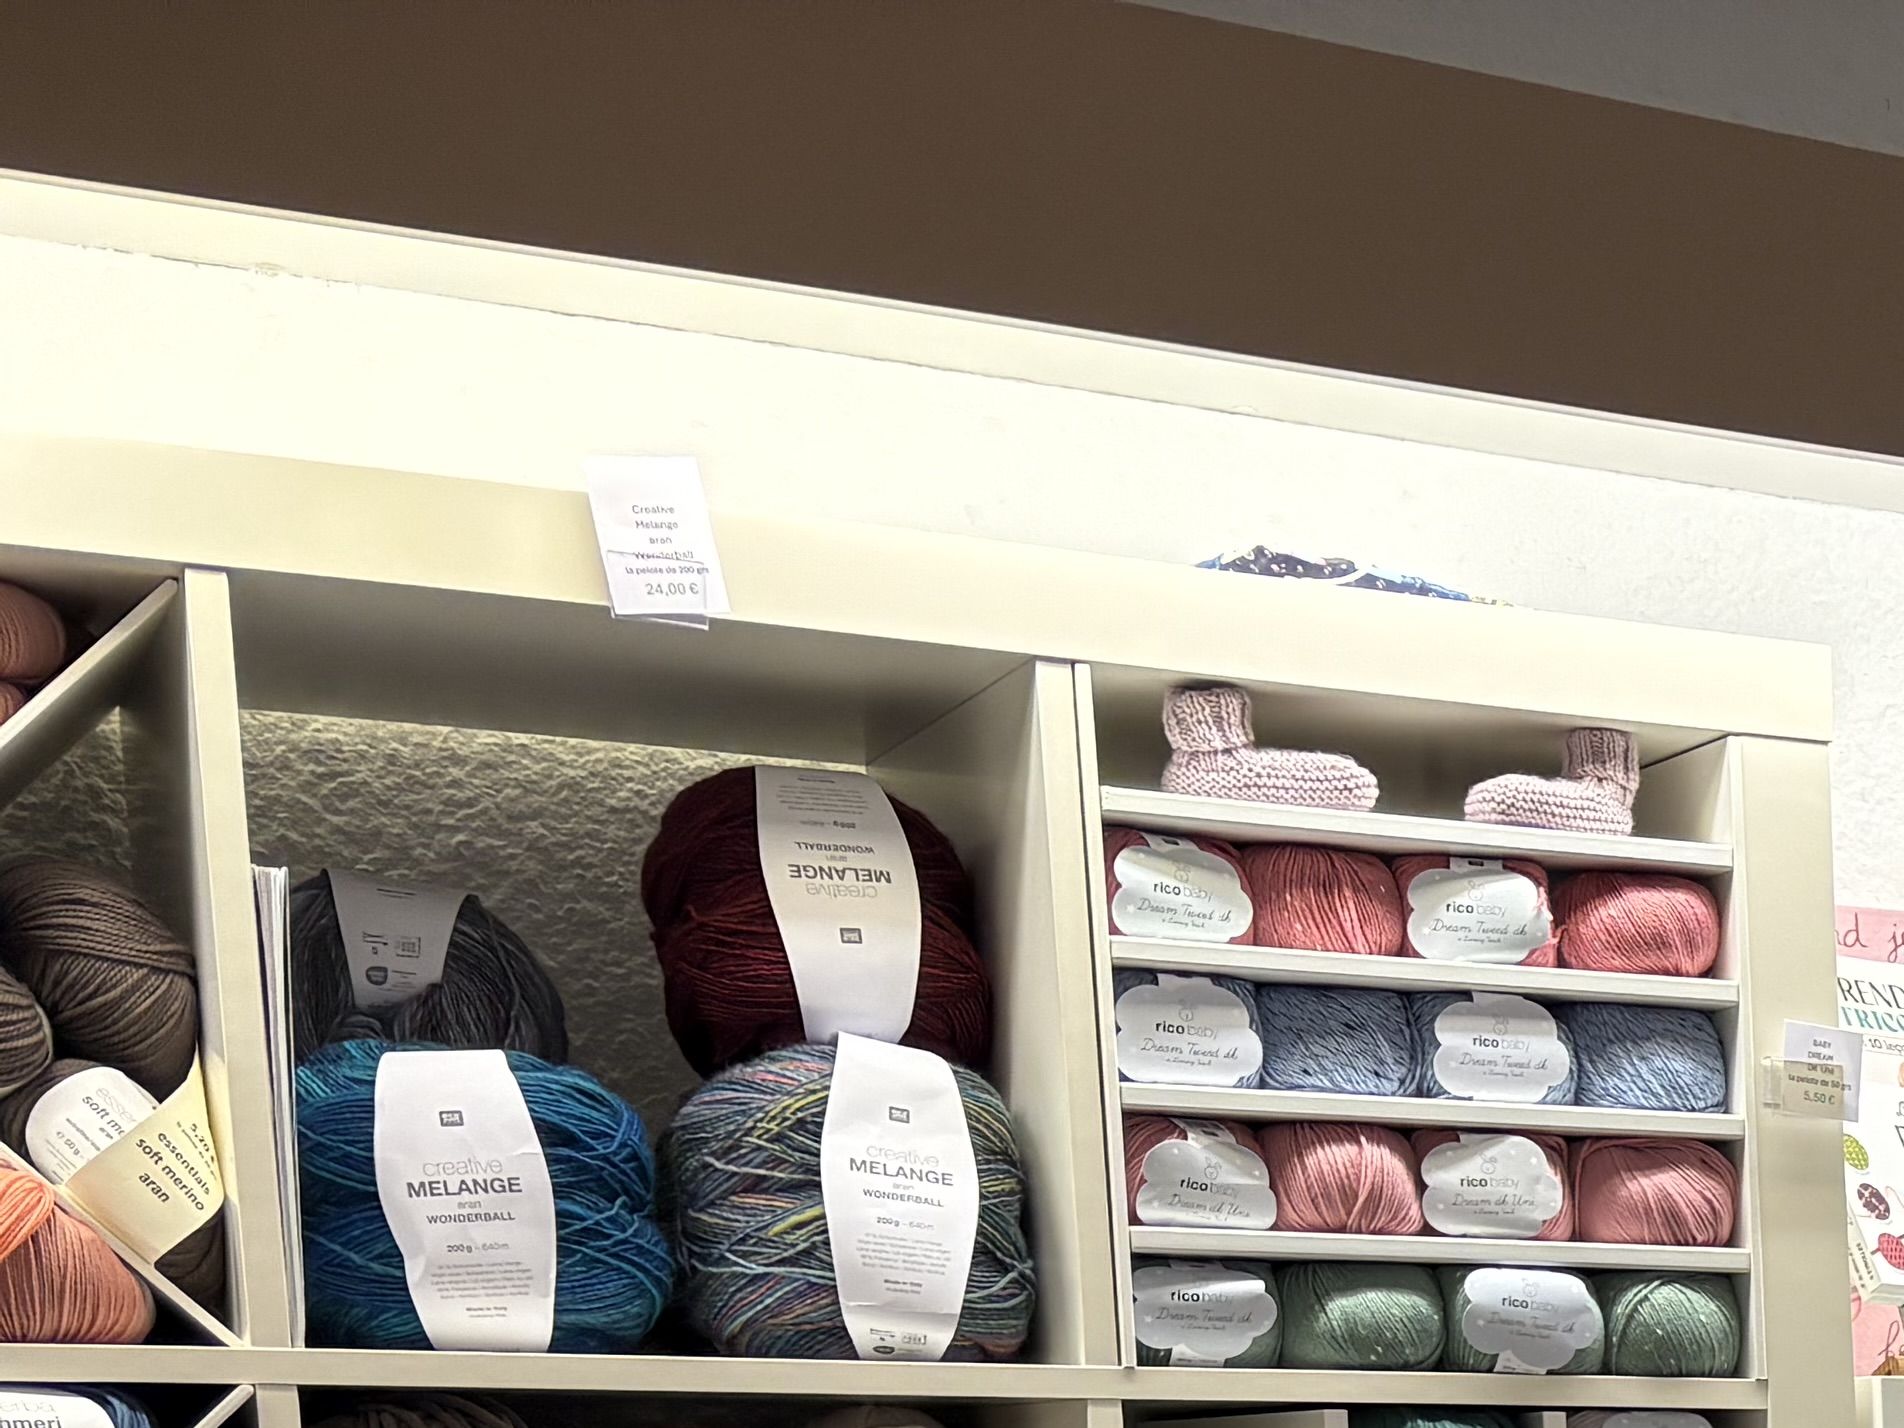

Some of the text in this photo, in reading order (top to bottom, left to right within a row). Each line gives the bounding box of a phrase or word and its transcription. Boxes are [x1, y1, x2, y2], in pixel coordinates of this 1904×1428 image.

[645, 582, 700, 597] 24,00 €
[787, 864, 892, 884] MELANGE
[806, 883, 878, 899] creative
[1153, 881, 1181, 896] rico
[1446, 901, 1474, 914] rico
[1155, 1021, 1185, 1035] rico
[1472, 1035, 1499, 1048] rico
[1866, 1037, 1881, 1049] 10
[1803, 1090, 1836, 1105] 5,50 €
[81, 1095, 108, 1121] soft
[158, 1131, 210, 1196] essentials
[866, 1145, 940, 1168] creative
[422, 1156, 504, 1177] creative
[849, 1157, 954, 1187] MELANGE
[135, 1137, 205, 1212] soft merino
[1460, 1175, 1488, 1189] rico
[138, 1172, 170, 1203] aran
[406, 1176, 523, 1199] MELANGE
[1180, 1177, 1208, 1191] rico
[457, 1200, 482, 1210] aran
[862, 1188, 944, 1208] WONDERBALL
[426, 1211, 516, 1225] WONDERBALL
[1171, 1289, 1200, 1304] rico
[1501, 1295, 1528, 1309] rico
